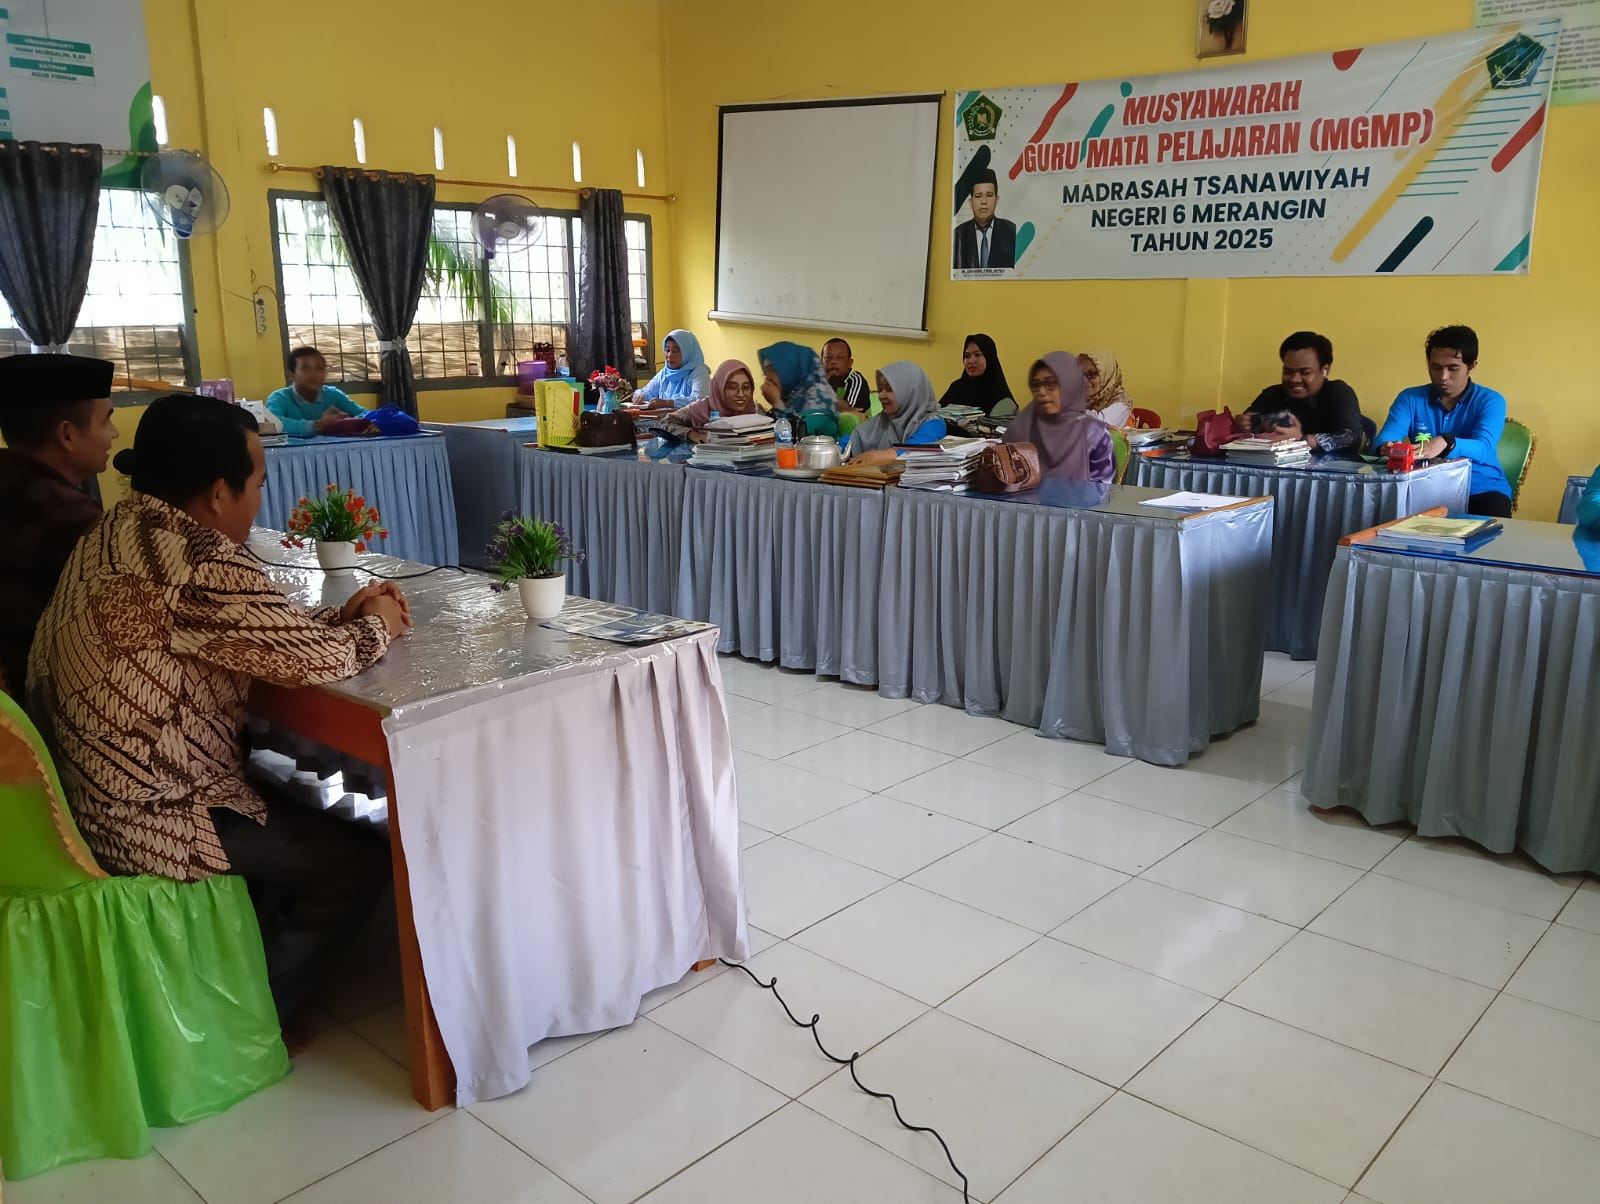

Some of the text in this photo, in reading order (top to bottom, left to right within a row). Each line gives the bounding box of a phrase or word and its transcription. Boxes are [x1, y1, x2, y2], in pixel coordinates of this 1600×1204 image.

[1122, 79, 1303, 127] MUSYAWARAH
[1023, 108, 1434, 173] GURU MATA PELAJARAN (MGMP)
[1062, 166, 1371, 204] MADRASAH TSANAWIYAH
[1091, 198, 1327, 228] NEGERI 6 MERANGIN
[1130, 227, 1274, 253] TAHUN 2025
